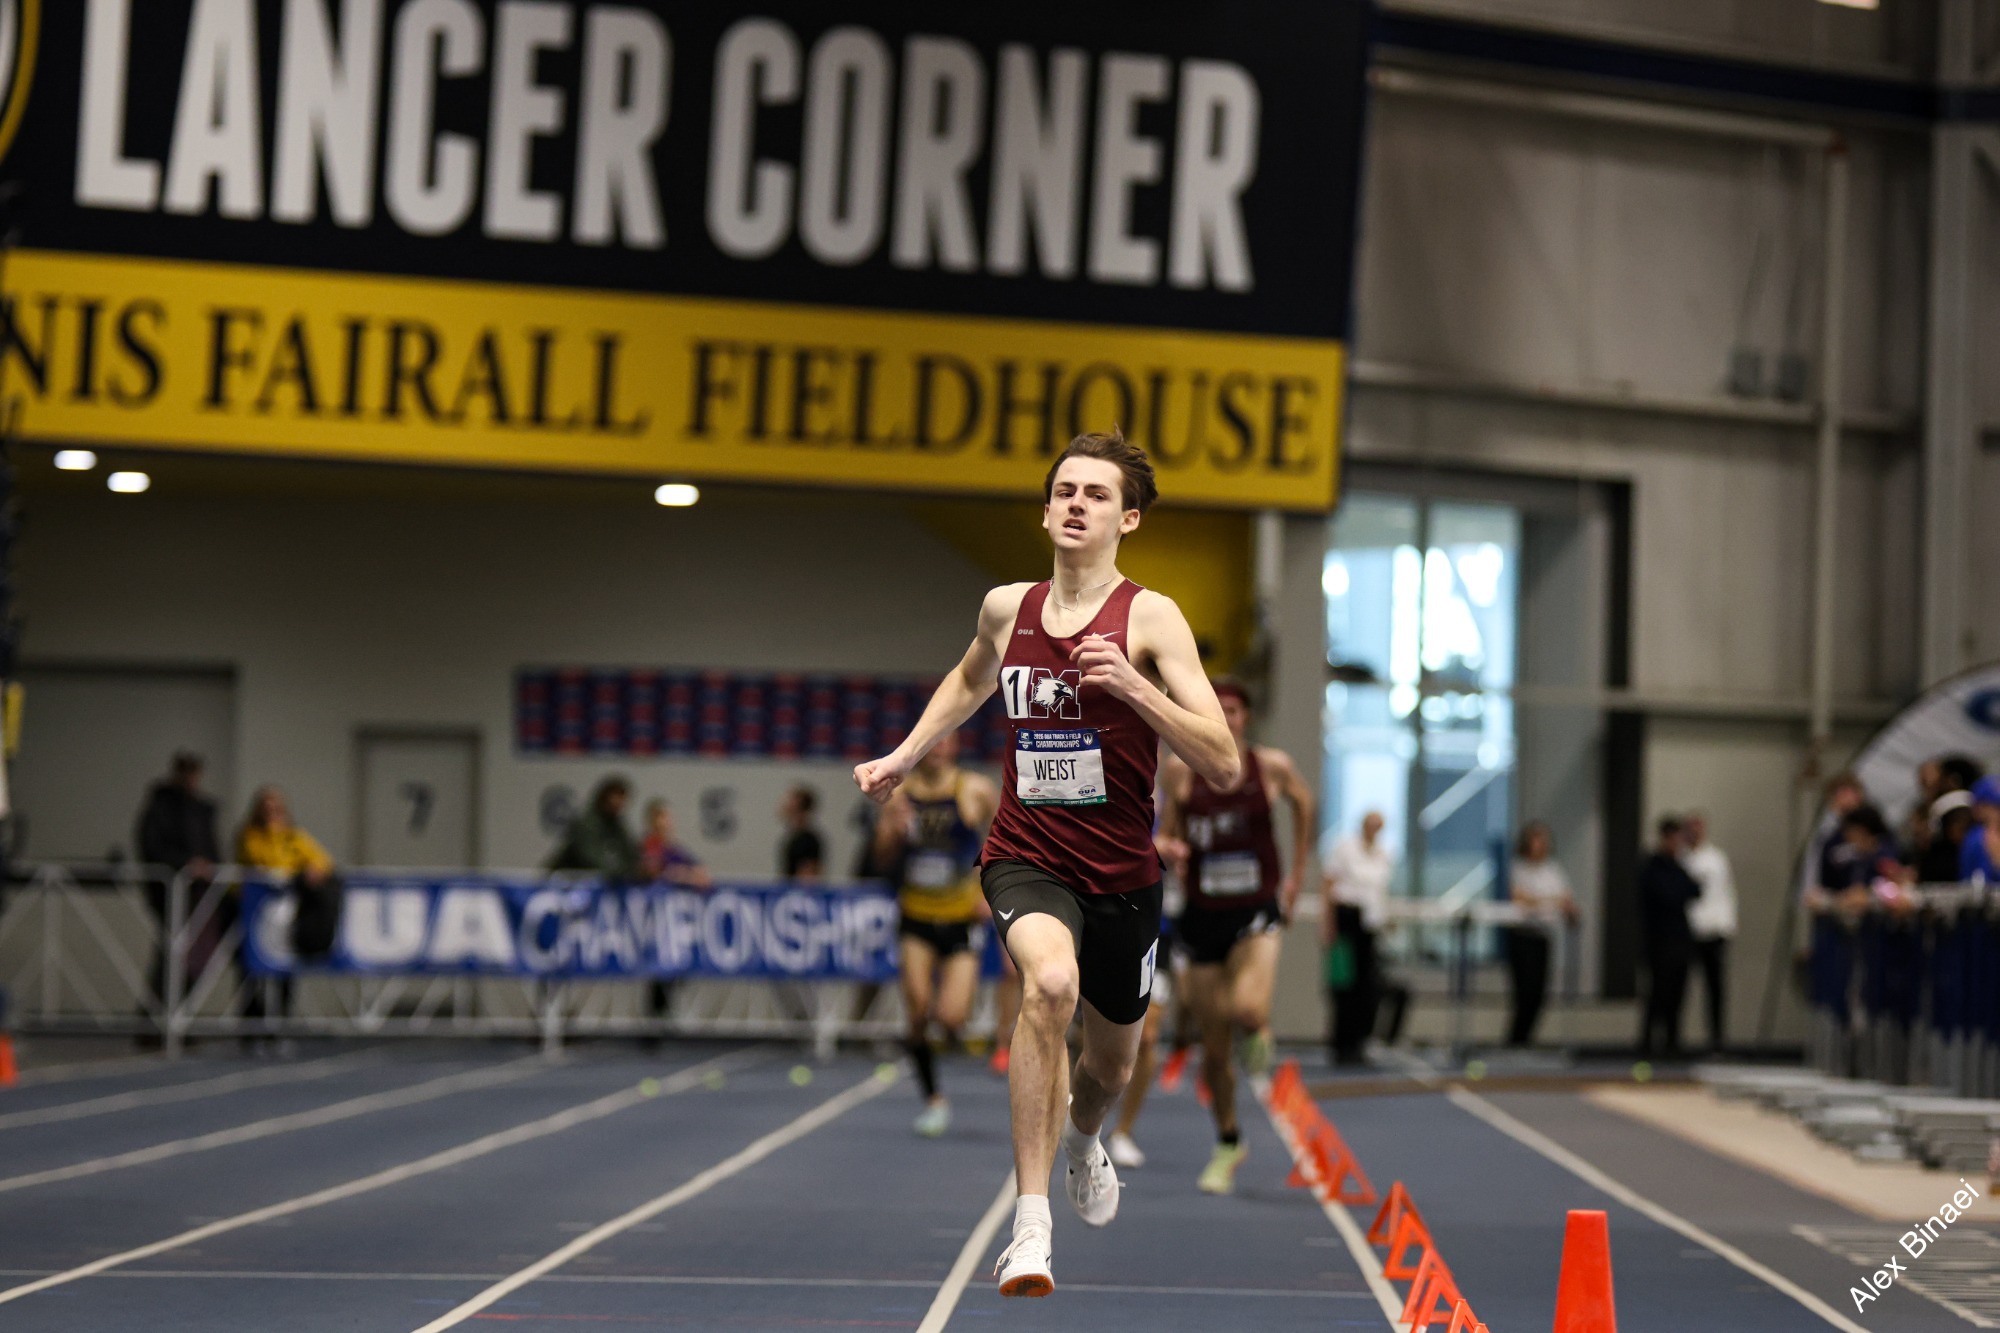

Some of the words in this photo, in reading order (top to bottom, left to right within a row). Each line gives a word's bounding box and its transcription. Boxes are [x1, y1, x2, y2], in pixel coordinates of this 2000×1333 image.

[74, 0, 673, 250] LANCER
[705, 17, 1262, 292] CORNER
[0, 292, 168, 411] NIS
[196, 306, 654, 438] FAIRALL
[680, 336, 1321, 476] FIELDHOUSE
[1017, 628, 1035, 636] OUA
[1007, 669, 1021, 716] 1
[1035, 740, 1080, 749] CHAMPIONSHIPS
[1033, 758, 1077, 781] WEIST
[404, 780, 434, 837] 7
[1078, 787, 1097, 796] OUA
